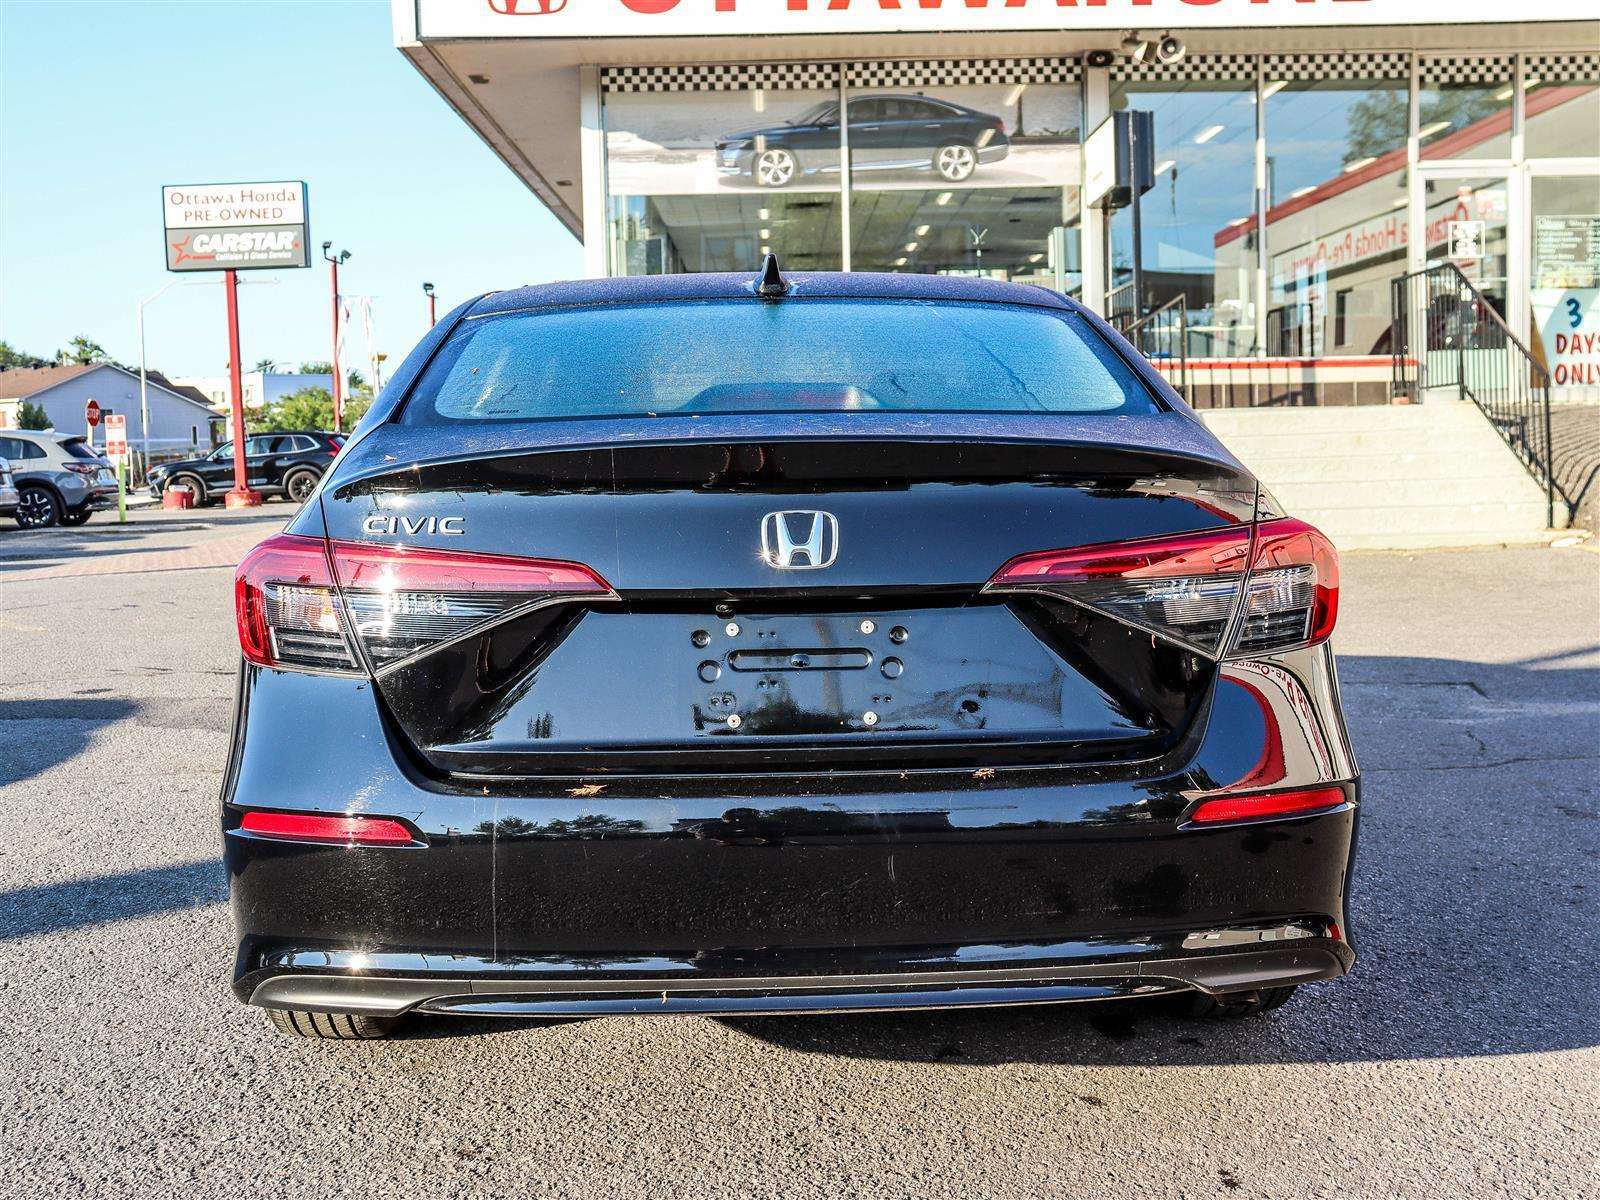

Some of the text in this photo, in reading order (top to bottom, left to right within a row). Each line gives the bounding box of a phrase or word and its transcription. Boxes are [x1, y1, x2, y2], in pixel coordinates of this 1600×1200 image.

[171, 189, 296, 205] Ottawa Honda
[185, 208, 283, 222] PRE-OWNED
[193, 231, 294, 253] CARSTAR
[1566, 298, 1582, 328] 3
[1555, 363, 1600, 385] ONL
[362, 516, 465, 534] CIVIC
